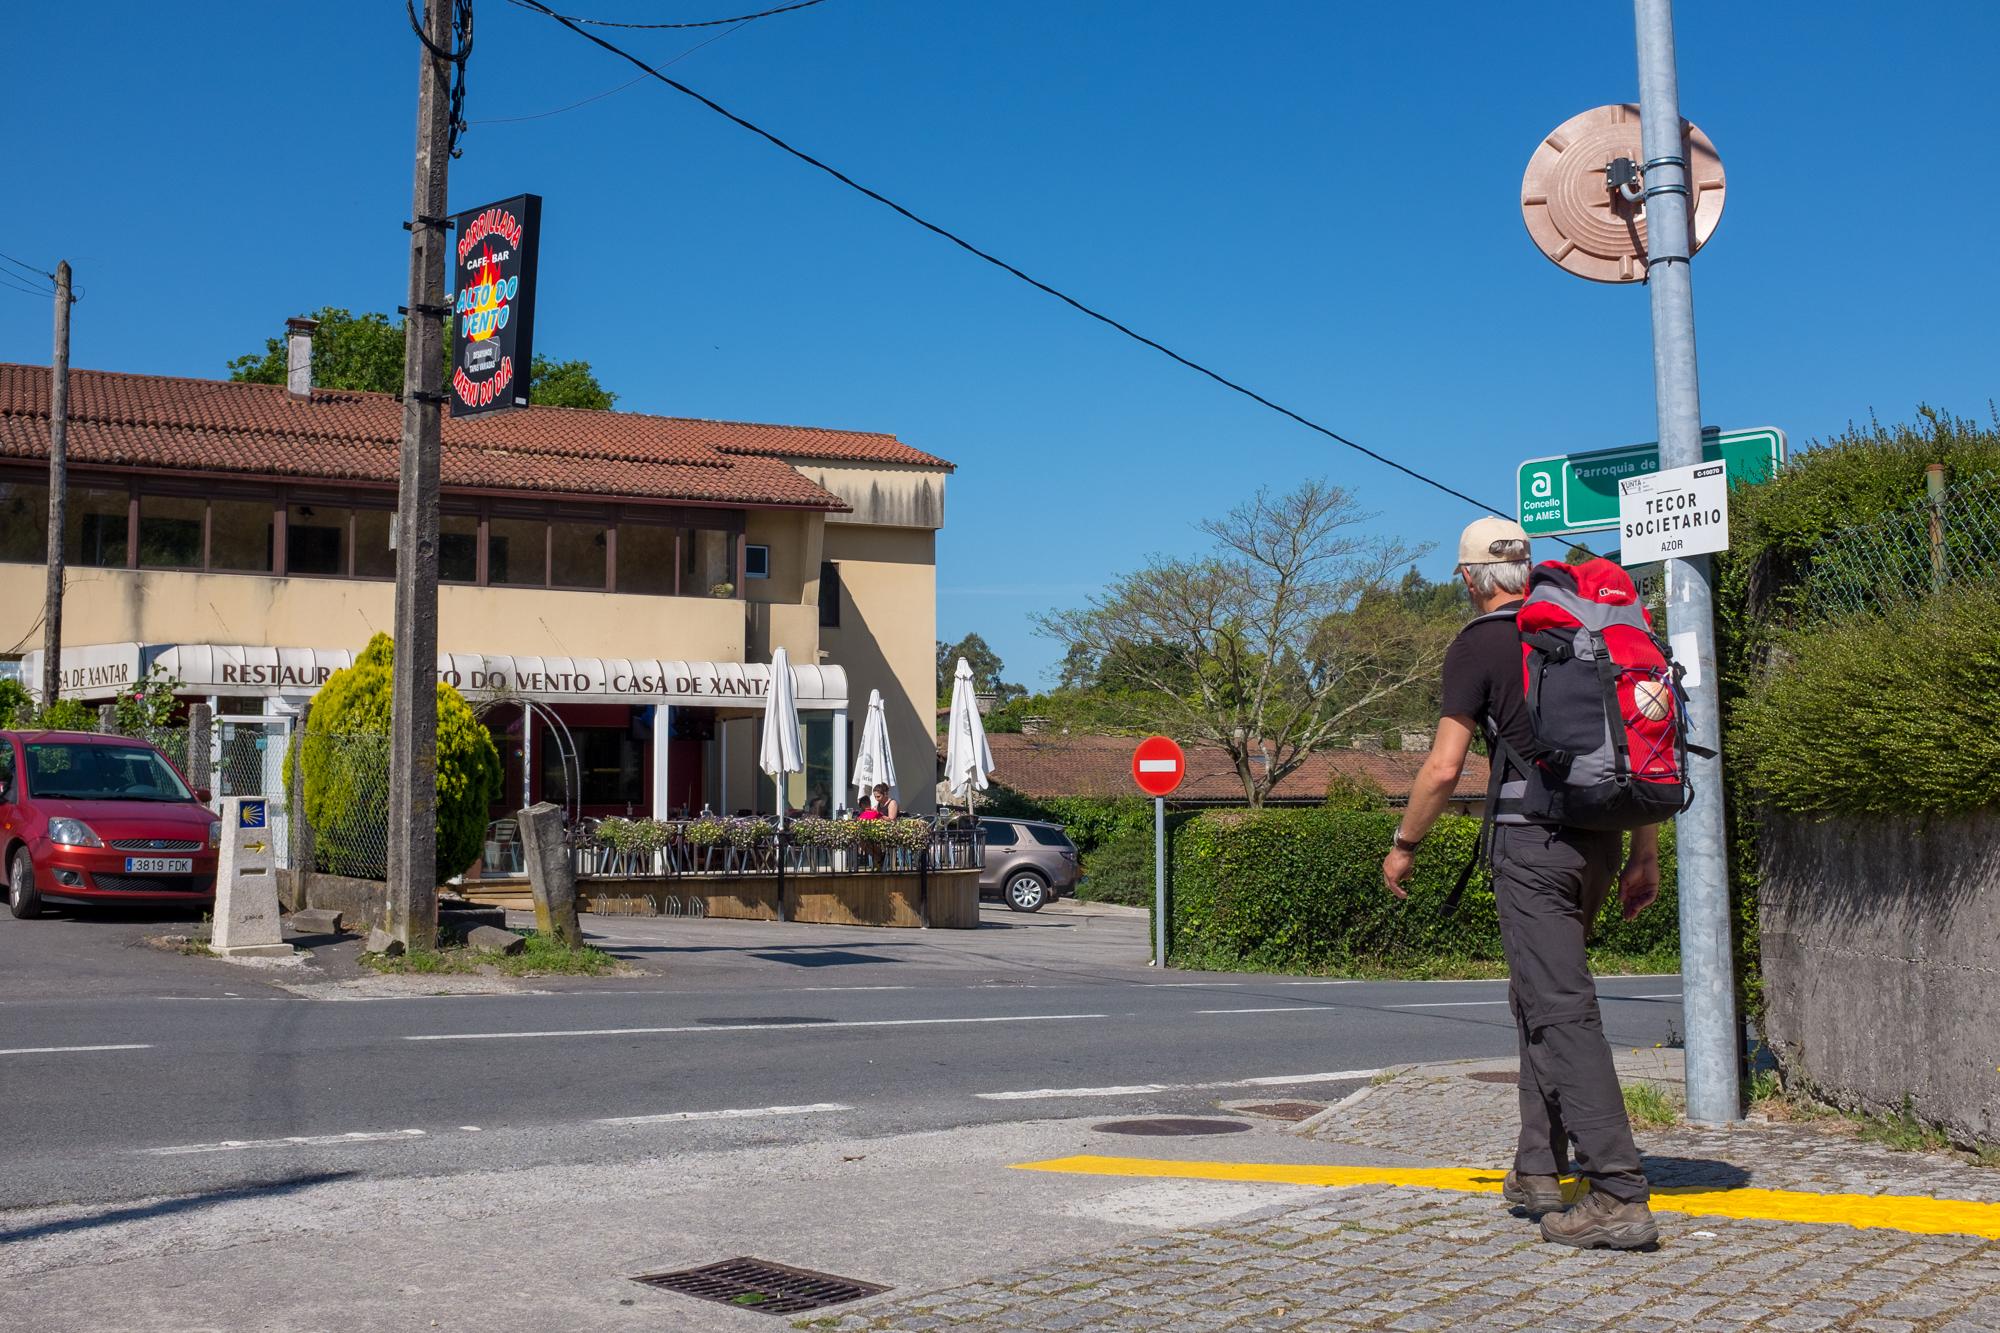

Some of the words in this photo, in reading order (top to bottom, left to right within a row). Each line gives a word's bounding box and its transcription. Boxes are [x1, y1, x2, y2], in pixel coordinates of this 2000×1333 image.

[458, 208, 521, 266] PARRILLADA
[491, 250, 509, 263] BAR
[457, 283, 491, 313] ALTO
[495, 275, 518, 303] DO
[462, 305, 510, 338] VENTO
[480, 377, 494, 407] DO
[1575, 464, 1635, 480] Parroquia
[1640, 460, 1656, 470] de
[1523, 498, 1560, 510] Concello
[1646, 493, 1697, 515] TECOR
[1523, 513, 1534, 522] de
[1536, 510, 1561, 520] AMES
[1626, 509, 1721, 538] SOCIETARIO
[1661, 539, 1684, 552] AZOR
[72, 668, 85, 688] DE
[88, 663, 128, 686] XANTAR
[223, 664, 343, 685] RESTAUR
[471, 671, 507, 689] DO
[516, 672, 591, 692] VENTO
[613, 675, 668, 694] CASA
[676, 677, 703, 694] DE
[136, 860, 164, 871] 3819
[168, 860, 188, 871] FDK
